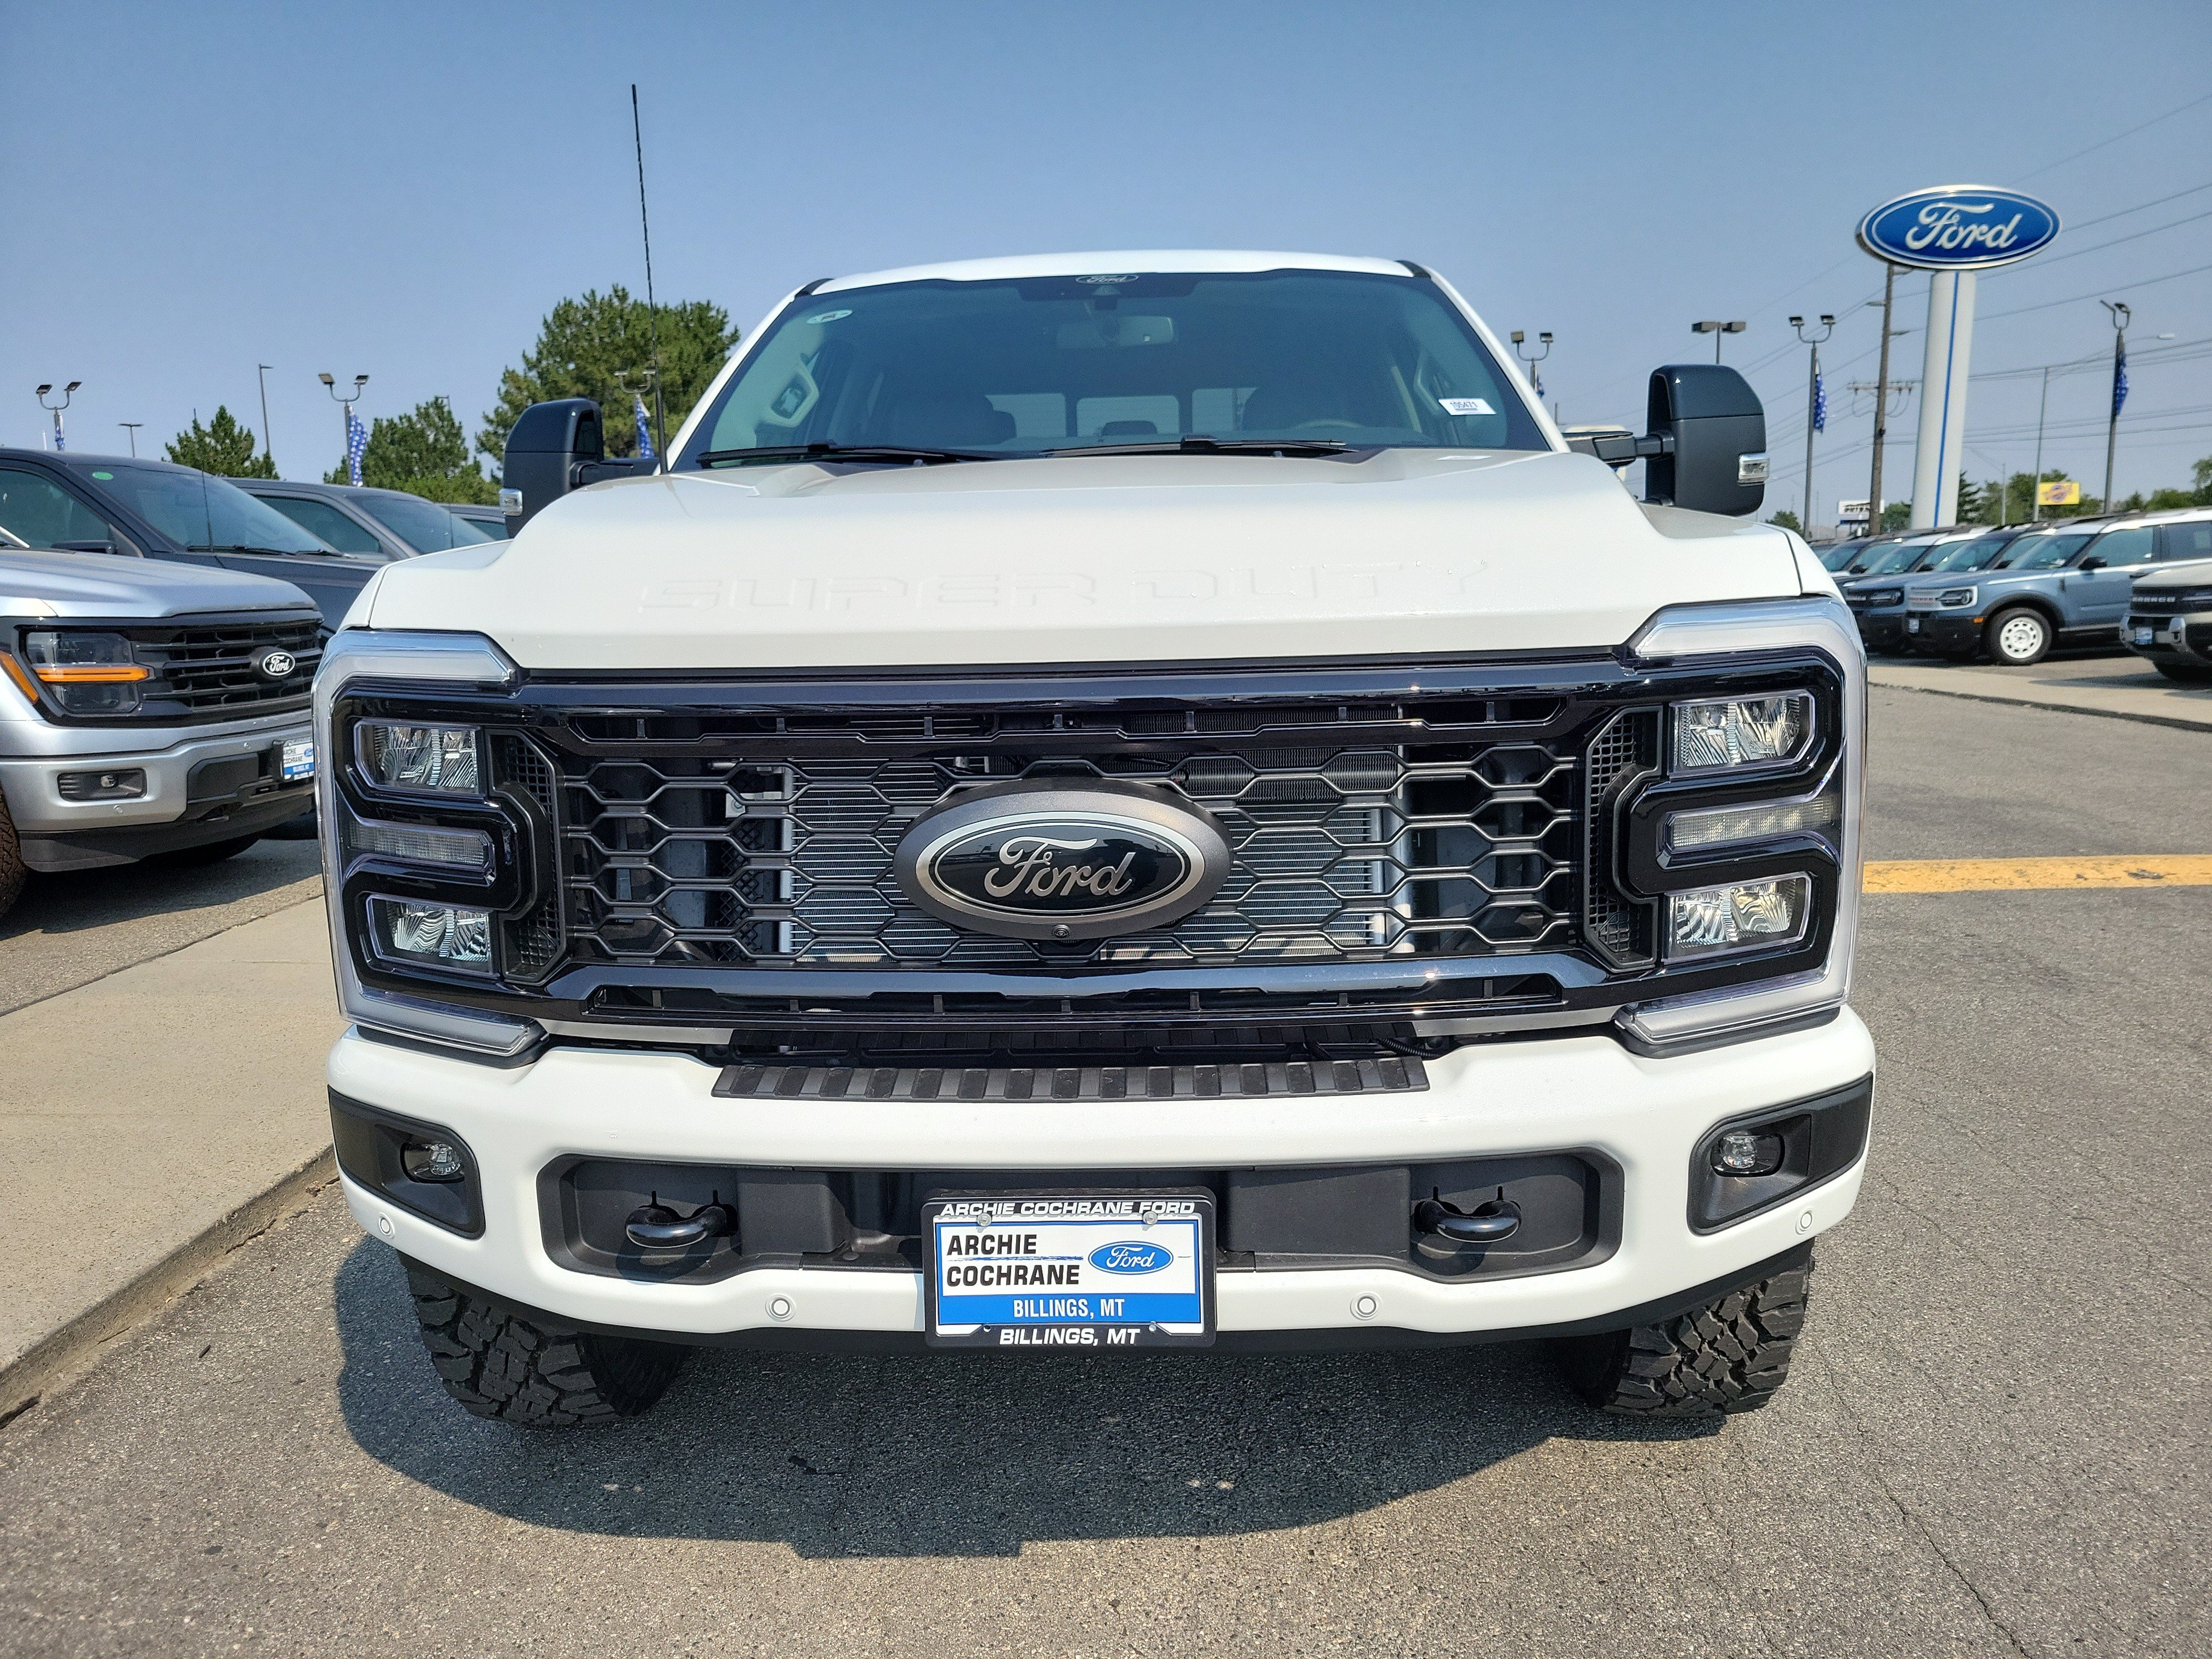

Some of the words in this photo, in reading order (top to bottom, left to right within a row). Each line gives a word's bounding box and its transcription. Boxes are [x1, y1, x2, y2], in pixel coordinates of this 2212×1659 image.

[1905, 201, 2023, 250] Ford
[638, 572, 1096, 613] SUPER
[1130, 559, 1488, 601] DUTY
[269, 656, 290, 672] Ford
[984, 836, 1136, 898] Ford
[940, 1202, 1015, 1216] ARCHIE
[1020, 1201, 1133, 1215] COCHRANE
[1138, 1201, 1195, 1214] FORD
[946, 1234, 1037, 1256] ARCHIE
[1106, 1246, 1156, 1268] Ford
[946, 1265, 1080, 1287] COCHRANE
[1013, 1299, 1094, 1319] BILLINGS,
[1100, 1299, 1125, 1317] MT
[999, 1328, 1098, 1346] BILLINGS,
[1107, 1328, 1141, 1345] MT
